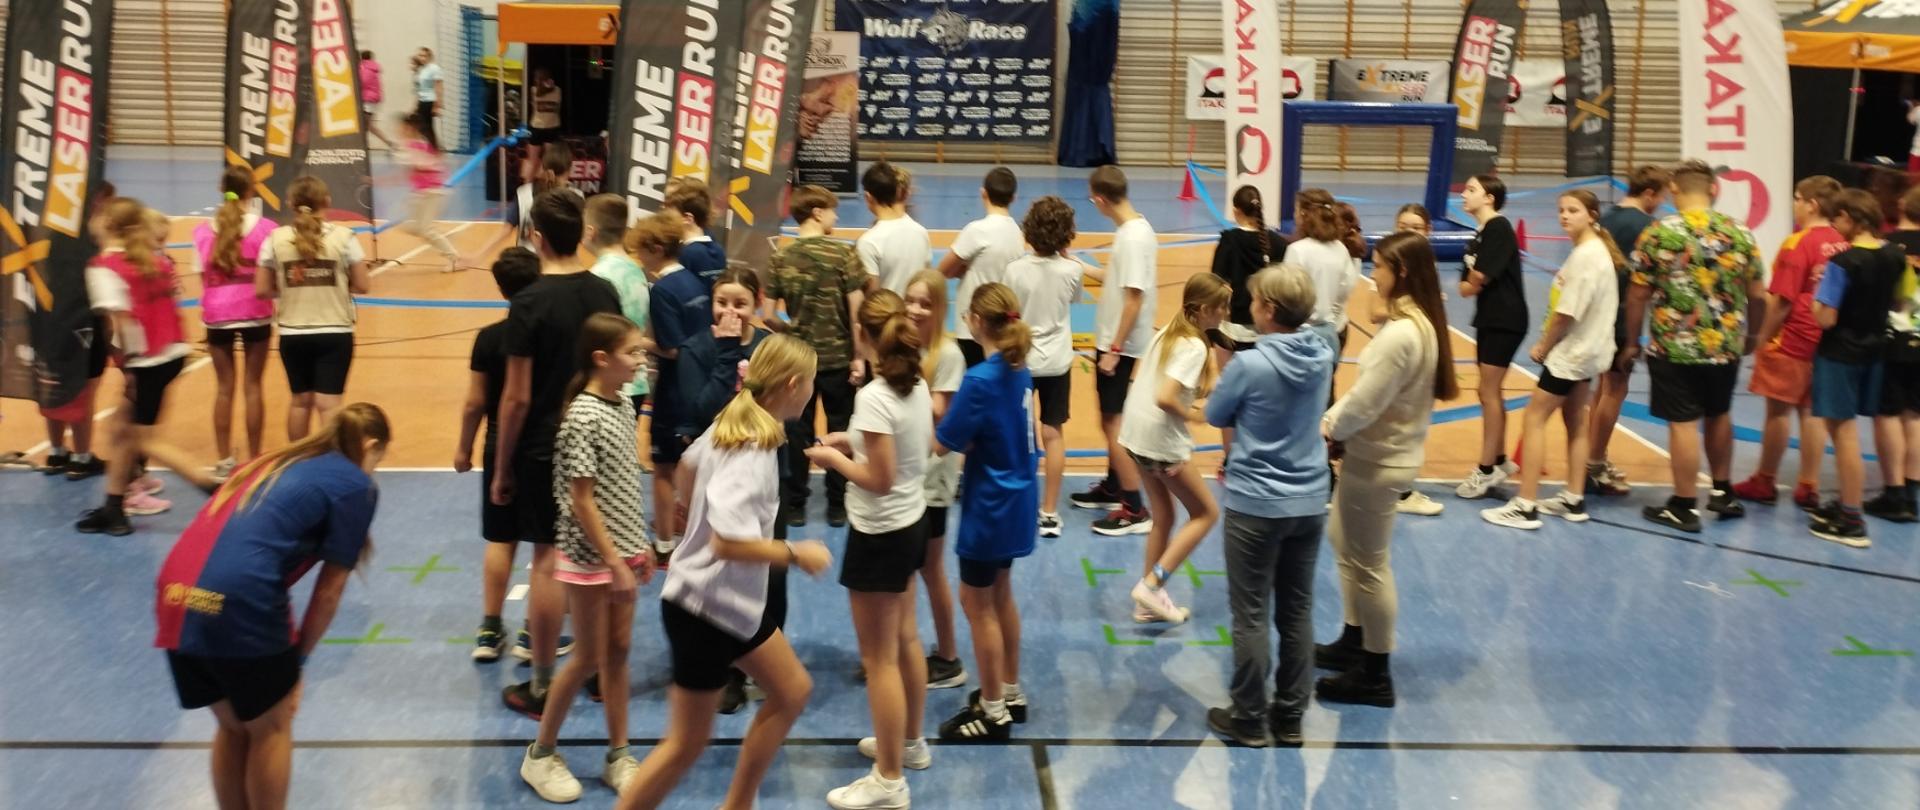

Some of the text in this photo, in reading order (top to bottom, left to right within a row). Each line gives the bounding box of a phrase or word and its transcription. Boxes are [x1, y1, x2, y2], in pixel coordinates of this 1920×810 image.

[60, 0, 92, 74] RU
[863, 18, 1028, 41] Wolf Race
[1456, 18, 1498, 129] LASER
[1488, 24, 1516, 80] RUN
[268, 46, 298, 154] LASER
[626, 58, 675, 229] TREME
[743, 61, 788, 171] LASER
